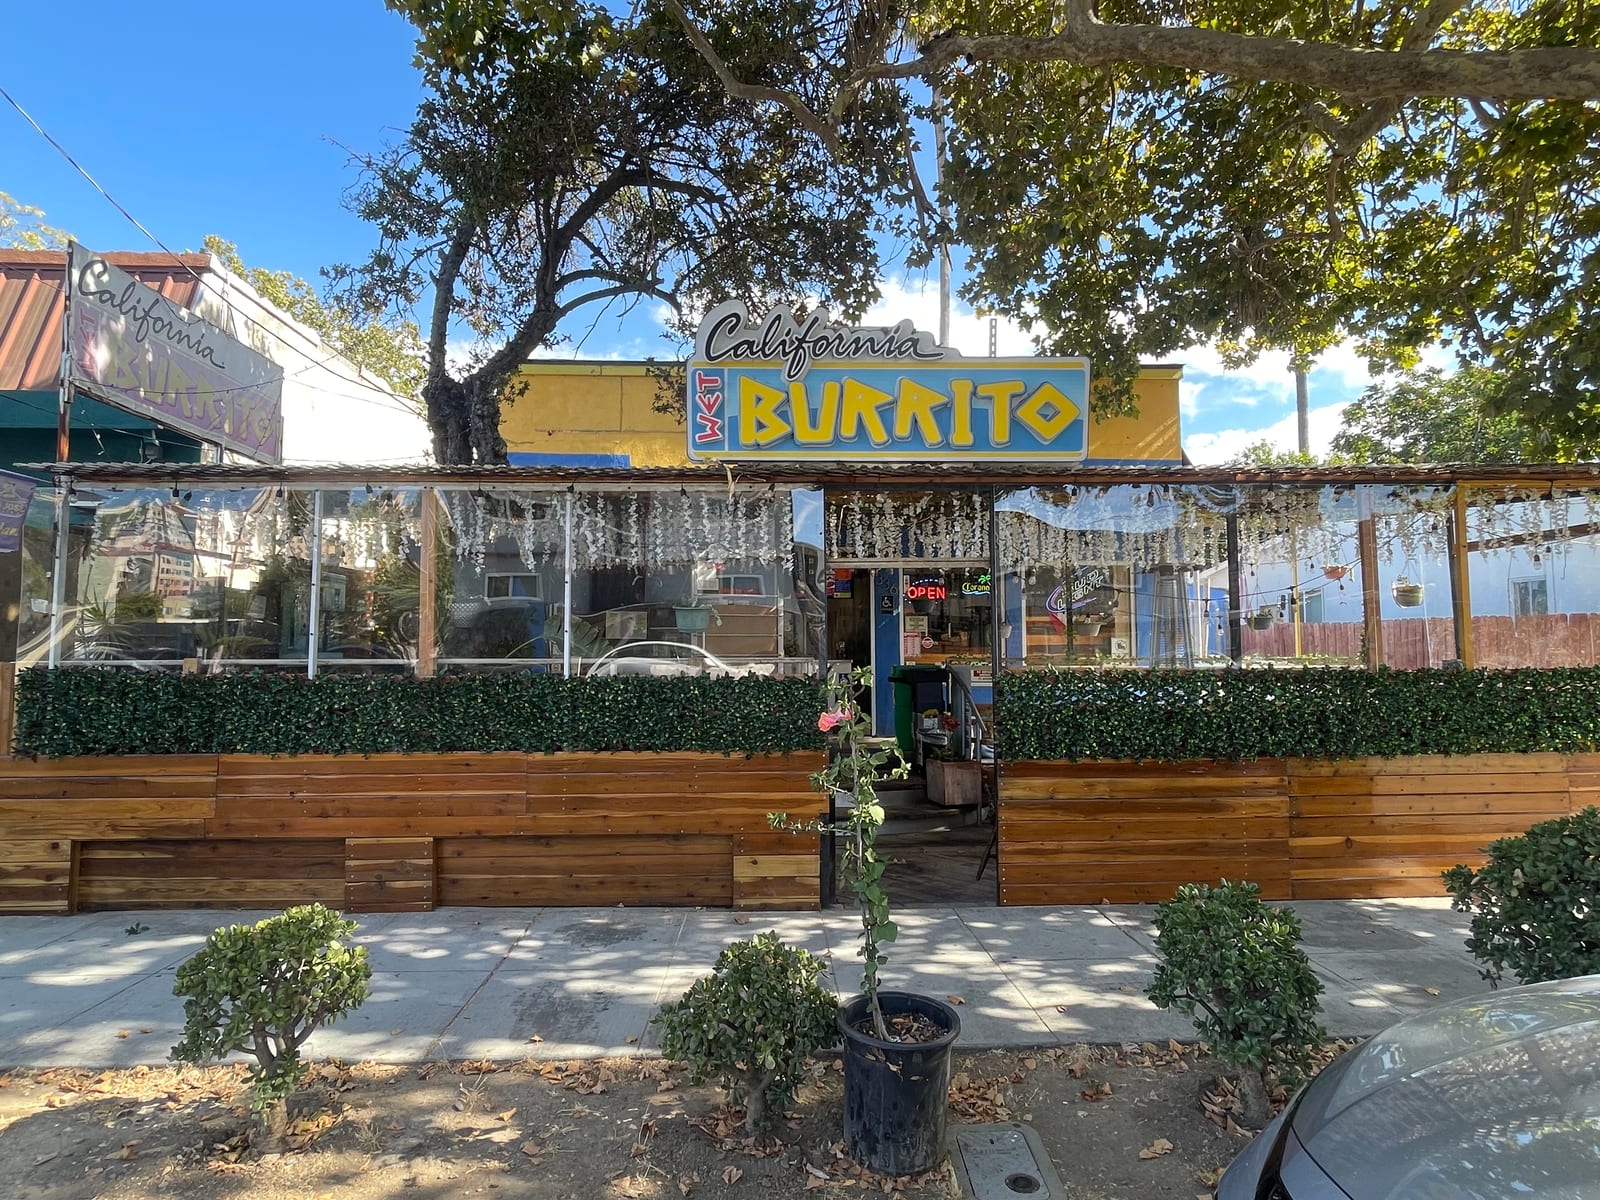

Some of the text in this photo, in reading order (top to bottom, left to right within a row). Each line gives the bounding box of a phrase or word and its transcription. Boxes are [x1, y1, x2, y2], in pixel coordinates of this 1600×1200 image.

[78, 259, 226, 370] California
[705, 312, 945, 382] California
[106, 334, 274, 442] BURRITO
[695, 371, 722, 444] WET
[738, 376, 1081, 448] BURRITO
[907, 586, 946, 600] OPEN
[962, 582, 991, 592] Corona
